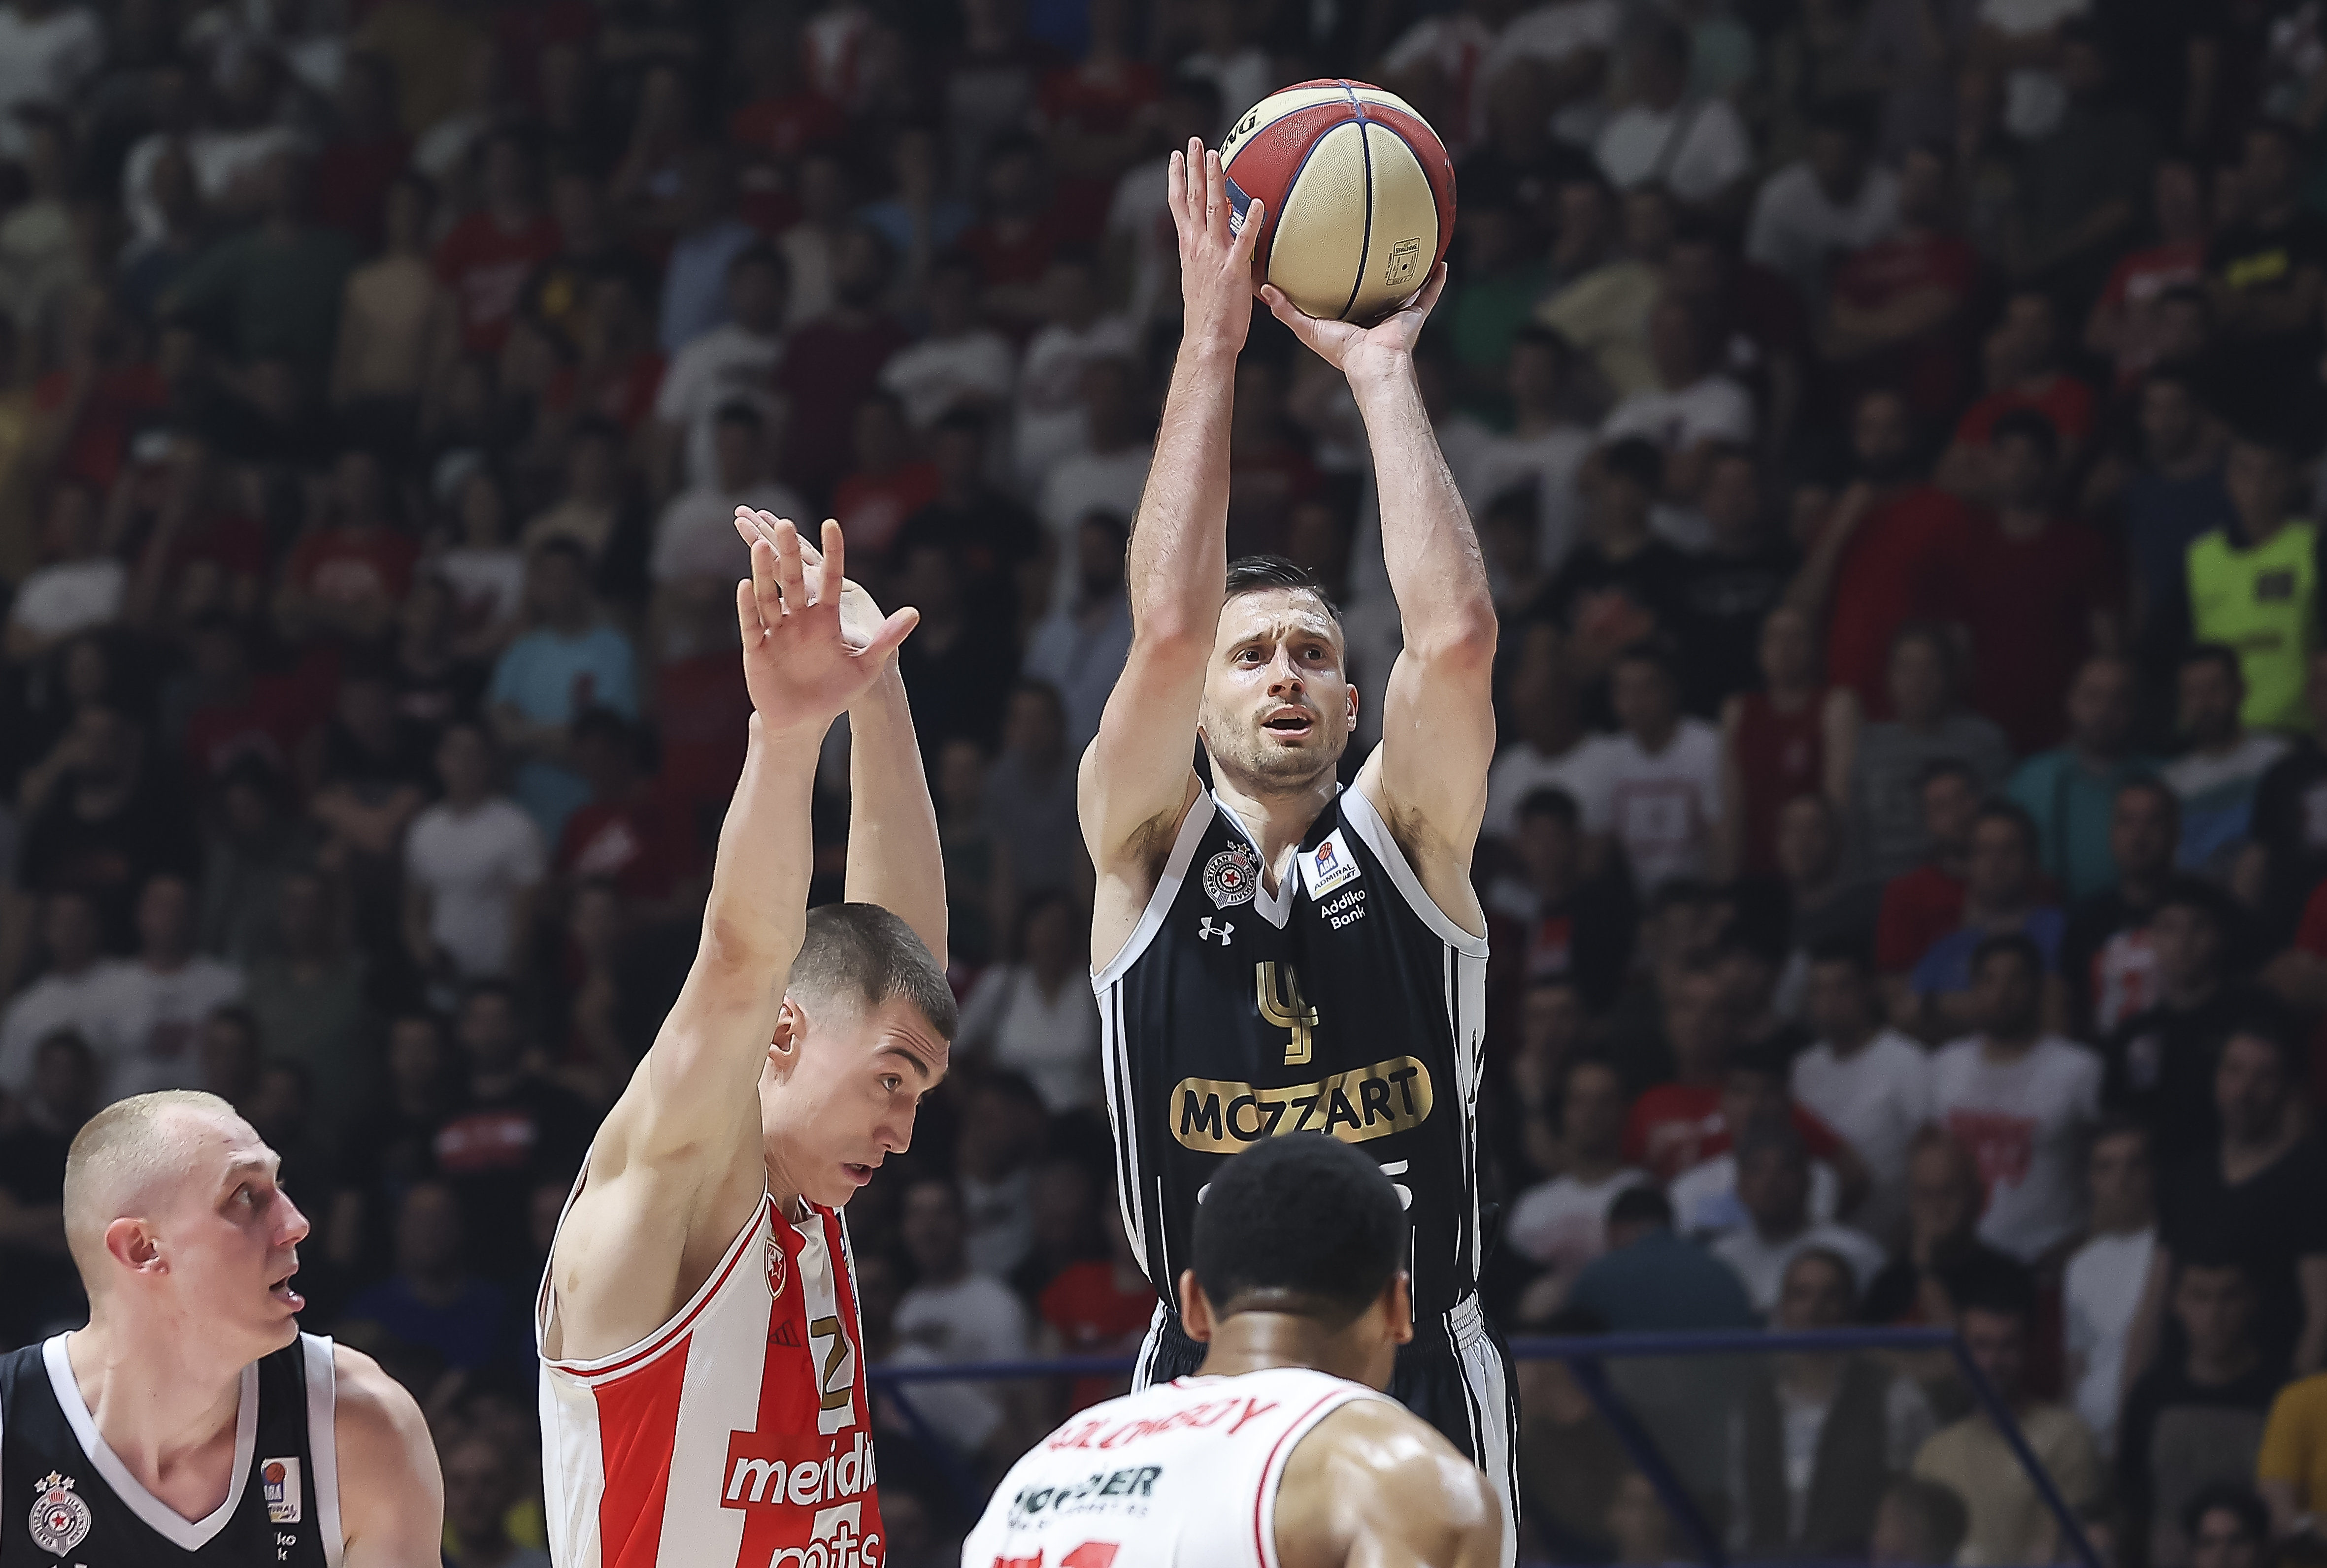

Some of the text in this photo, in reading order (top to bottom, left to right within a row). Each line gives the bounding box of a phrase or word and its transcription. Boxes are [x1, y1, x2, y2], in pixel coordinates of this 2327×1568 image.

[1221, 108, 1259, 158] NG
[1207, 855, 1231, 896] PARTIZAN
[1314, 864, 1355, 891] ADMIRAL
[1319, 855, 1336, 876] ABA
[1321, 890, 1365, 919] Addiko
[1330, 904, 1366, 930] Bank
[1180, 1066, 1419, 1142] MOZZART
[811, 1316, 848, 1410] 2
